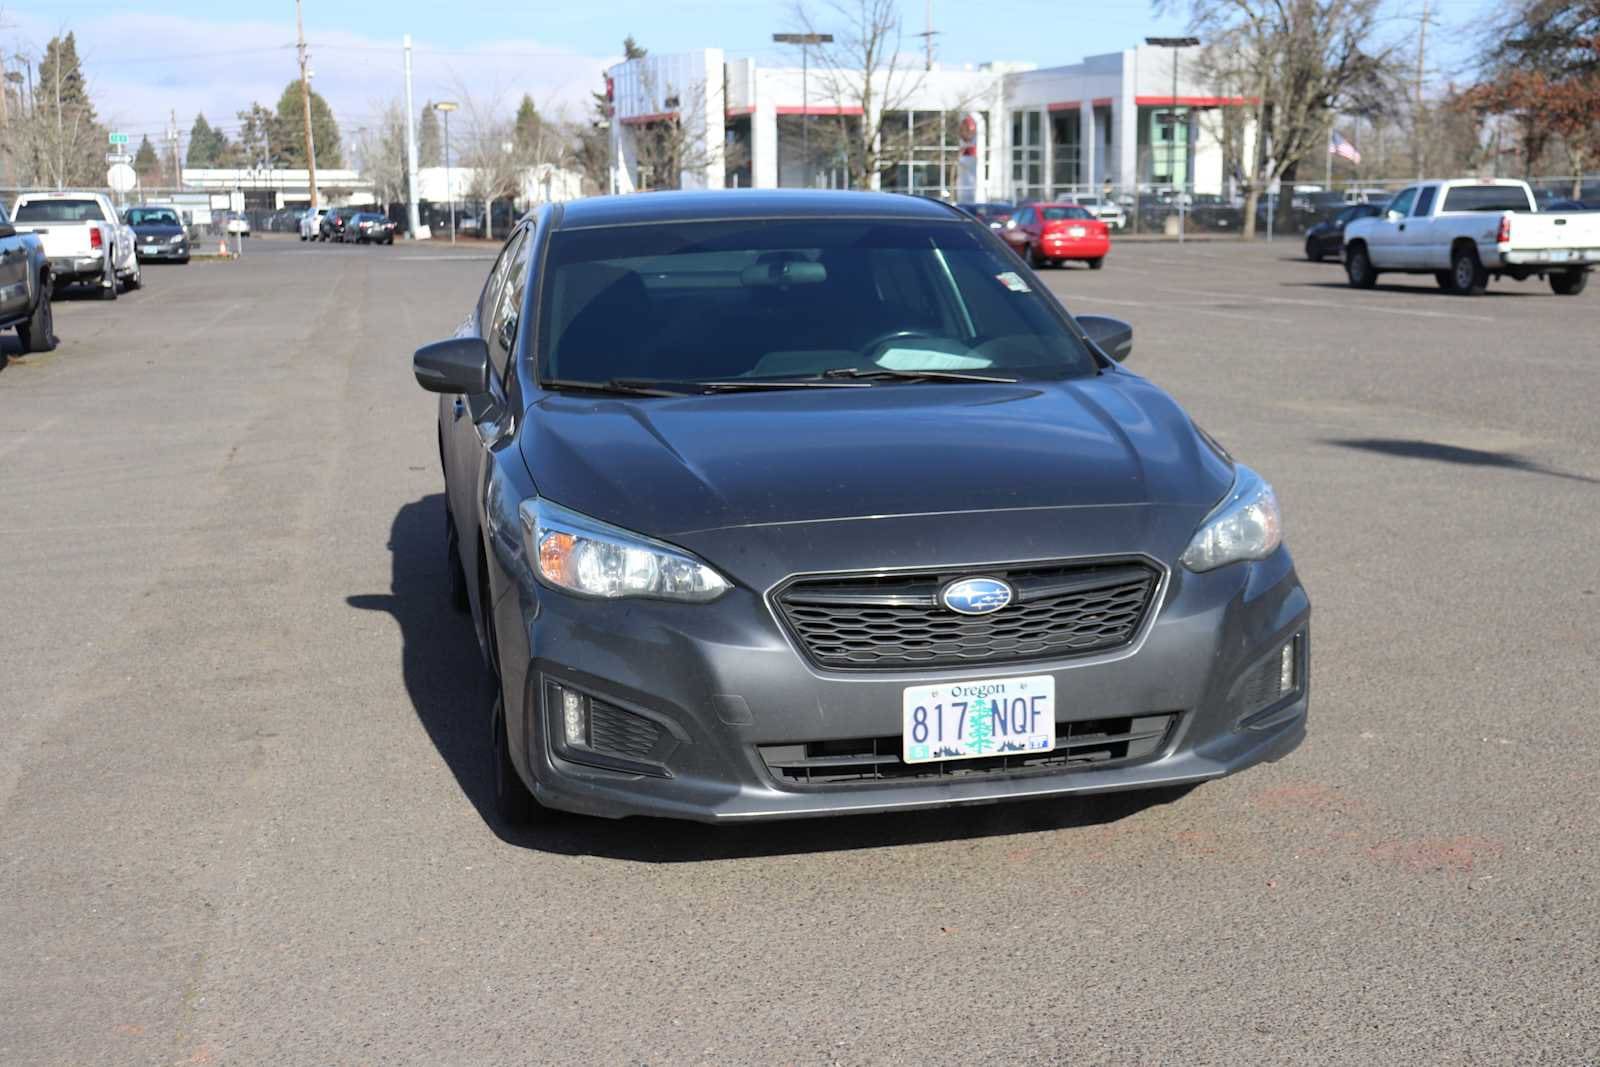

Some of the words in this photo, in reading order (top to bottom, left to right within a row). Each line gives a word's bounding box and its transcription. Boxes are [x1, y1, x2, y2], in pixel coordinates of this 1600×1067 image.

[951, 683, 1006, 698] Oregon
[912, 701, 968, 743] 817
[991, 695, 1047, 736] NQF
